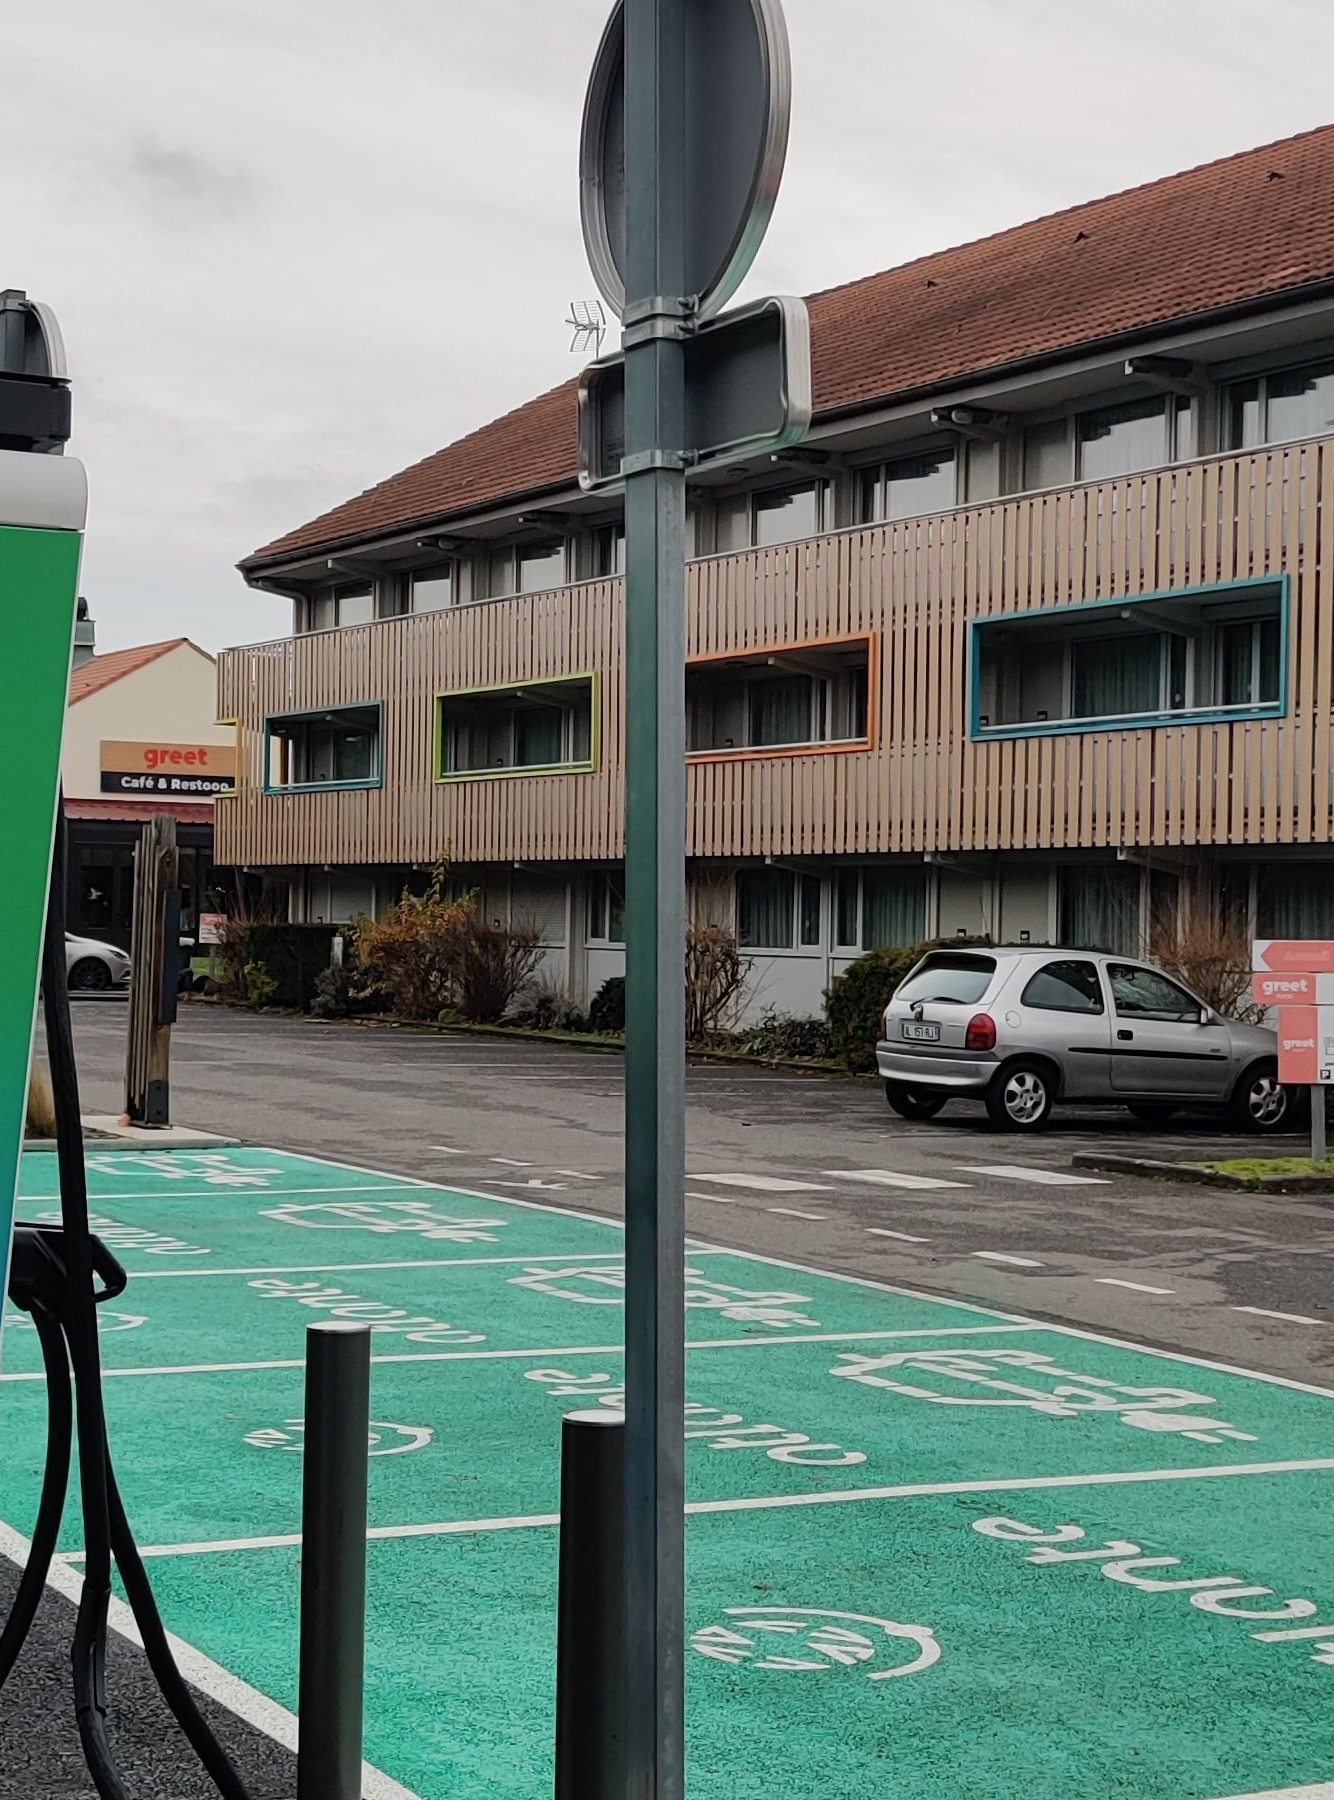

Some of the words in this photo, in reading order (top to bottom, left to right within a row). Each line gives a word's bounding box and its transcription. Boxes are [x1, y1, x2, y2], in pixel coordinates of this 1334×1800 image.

[143, 747, 208, 769] greet
[120, 775, 154, 789] Café
[157, 776, 167, 789] &
[1262, 979, 1308, 996] greet
[1283, 1038, 1315, 1050] greet
